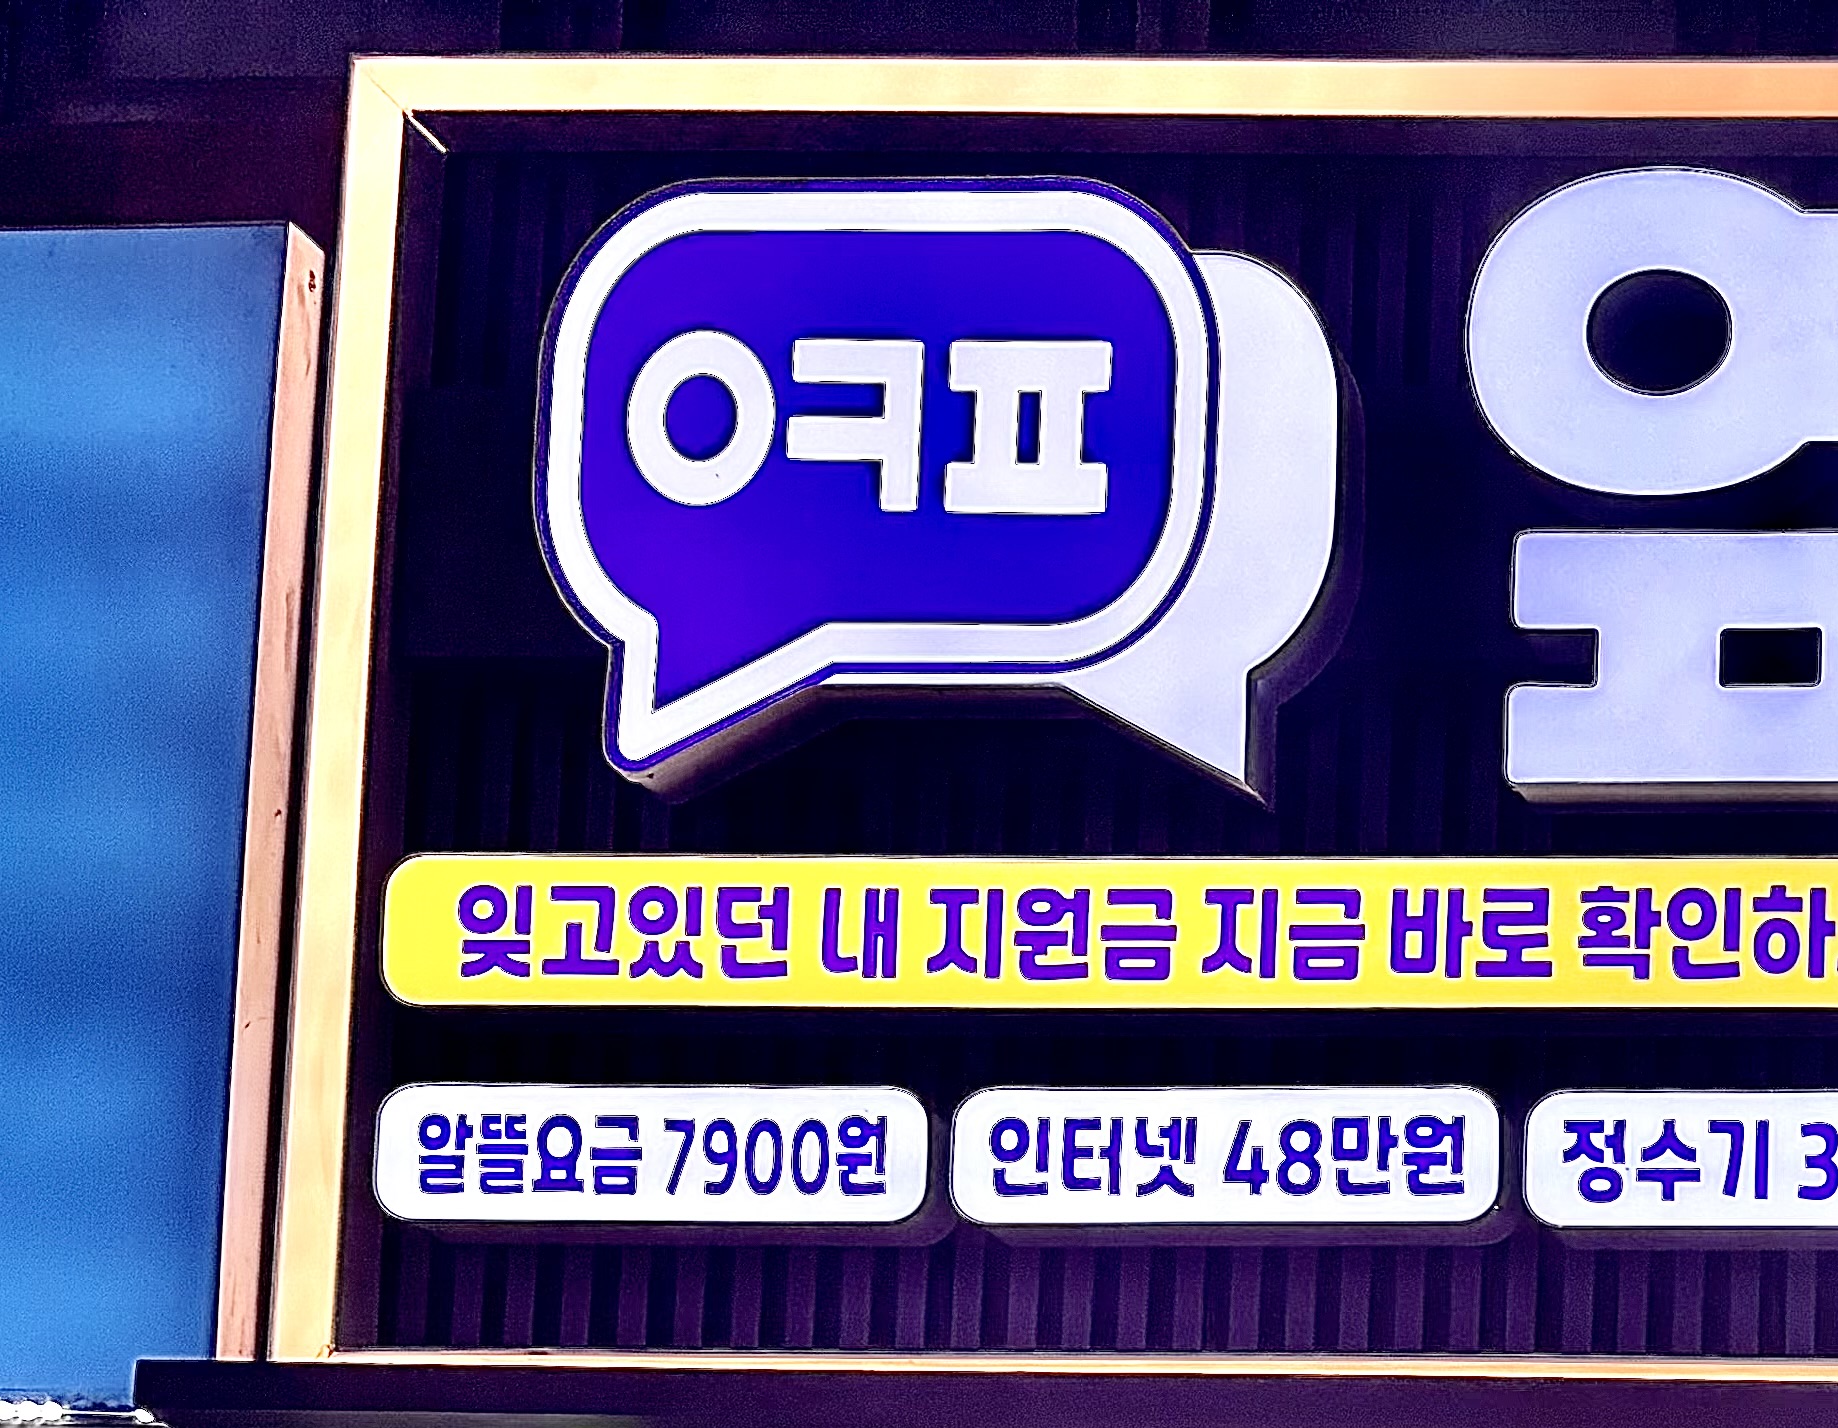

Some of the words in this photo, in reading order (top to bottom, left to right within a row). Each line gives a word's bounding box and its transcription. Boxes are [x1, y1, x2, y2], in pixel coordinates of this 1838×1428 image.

[456, 887, 788, 981] 잊고있던
[819, 887, 898, 980] 내
[927, 888, 1180, 980] 지원금
[1201, 888, 1364, 980] 지금
[1390, 887, 1555, 980] 바로
[415, 1115, 644, 1196] 알뜰요금
[663, 1113, 888, 1197] 7900원
[988, 1115, 1199, 1199] 인터넷
[1222, 1115, 1467, 1198] 48만원
[1561, 1120, 1771, 1203] 정수기
